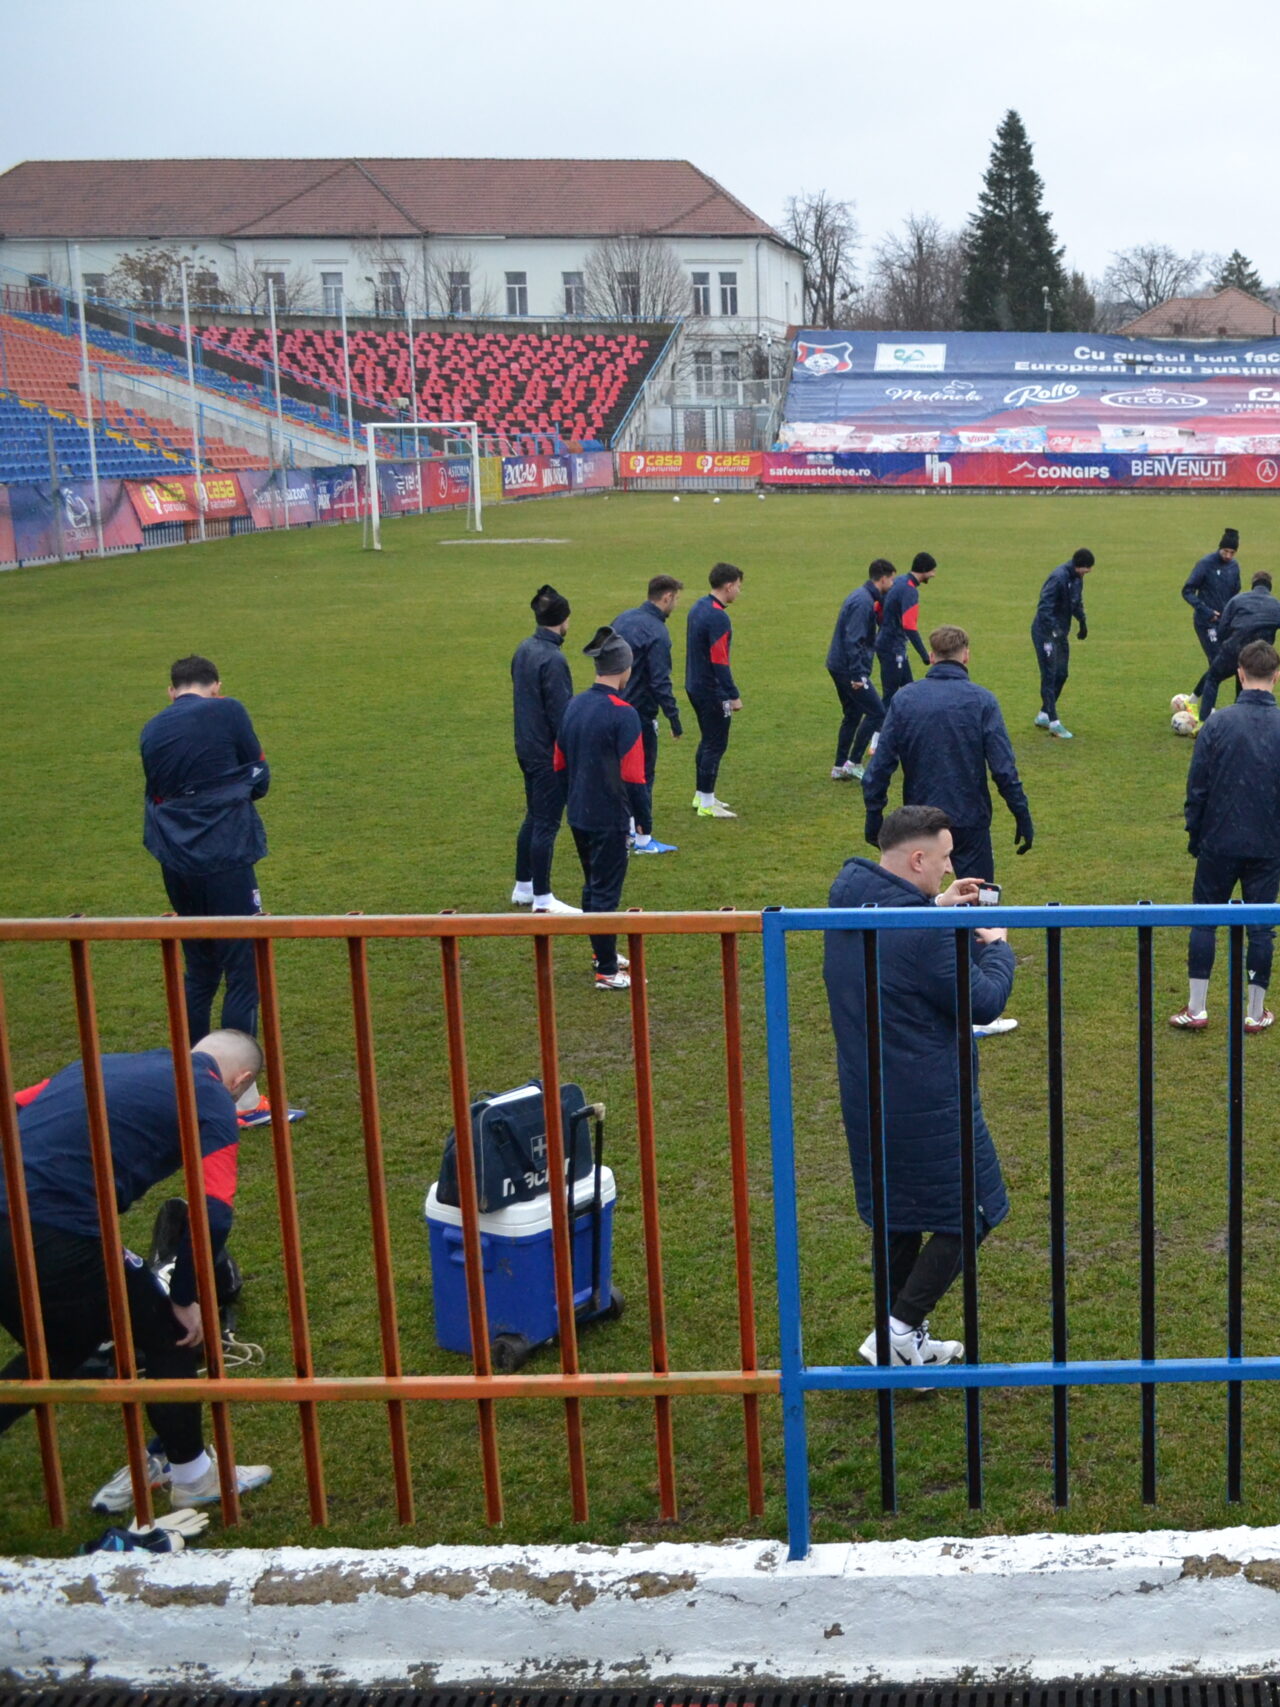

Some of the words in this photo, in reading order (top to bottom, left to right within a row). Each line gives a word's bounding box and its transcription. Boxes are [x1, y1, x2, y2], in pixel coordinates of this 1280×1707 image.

[1074, 346, 1105, 361] Cu
[1113, 352, 1186, 363] gustul
[1194, 353, 1237, 362] bun
[1014, 361, 1126, 374] European
[1117, 396, 1196, 405] REGAL
[645, 454, 683, 467] casa
[713, 454, 751, 467] casa
[1130, 455, 1227, 477] BENVENUTI
[713, 465, 750, 474] pariurilor
[769, 465, 872, 477] safewastedeee.ro
[1037, 466, 1111, 479] CONGIPS
[206, 479, 236, 499] casa
